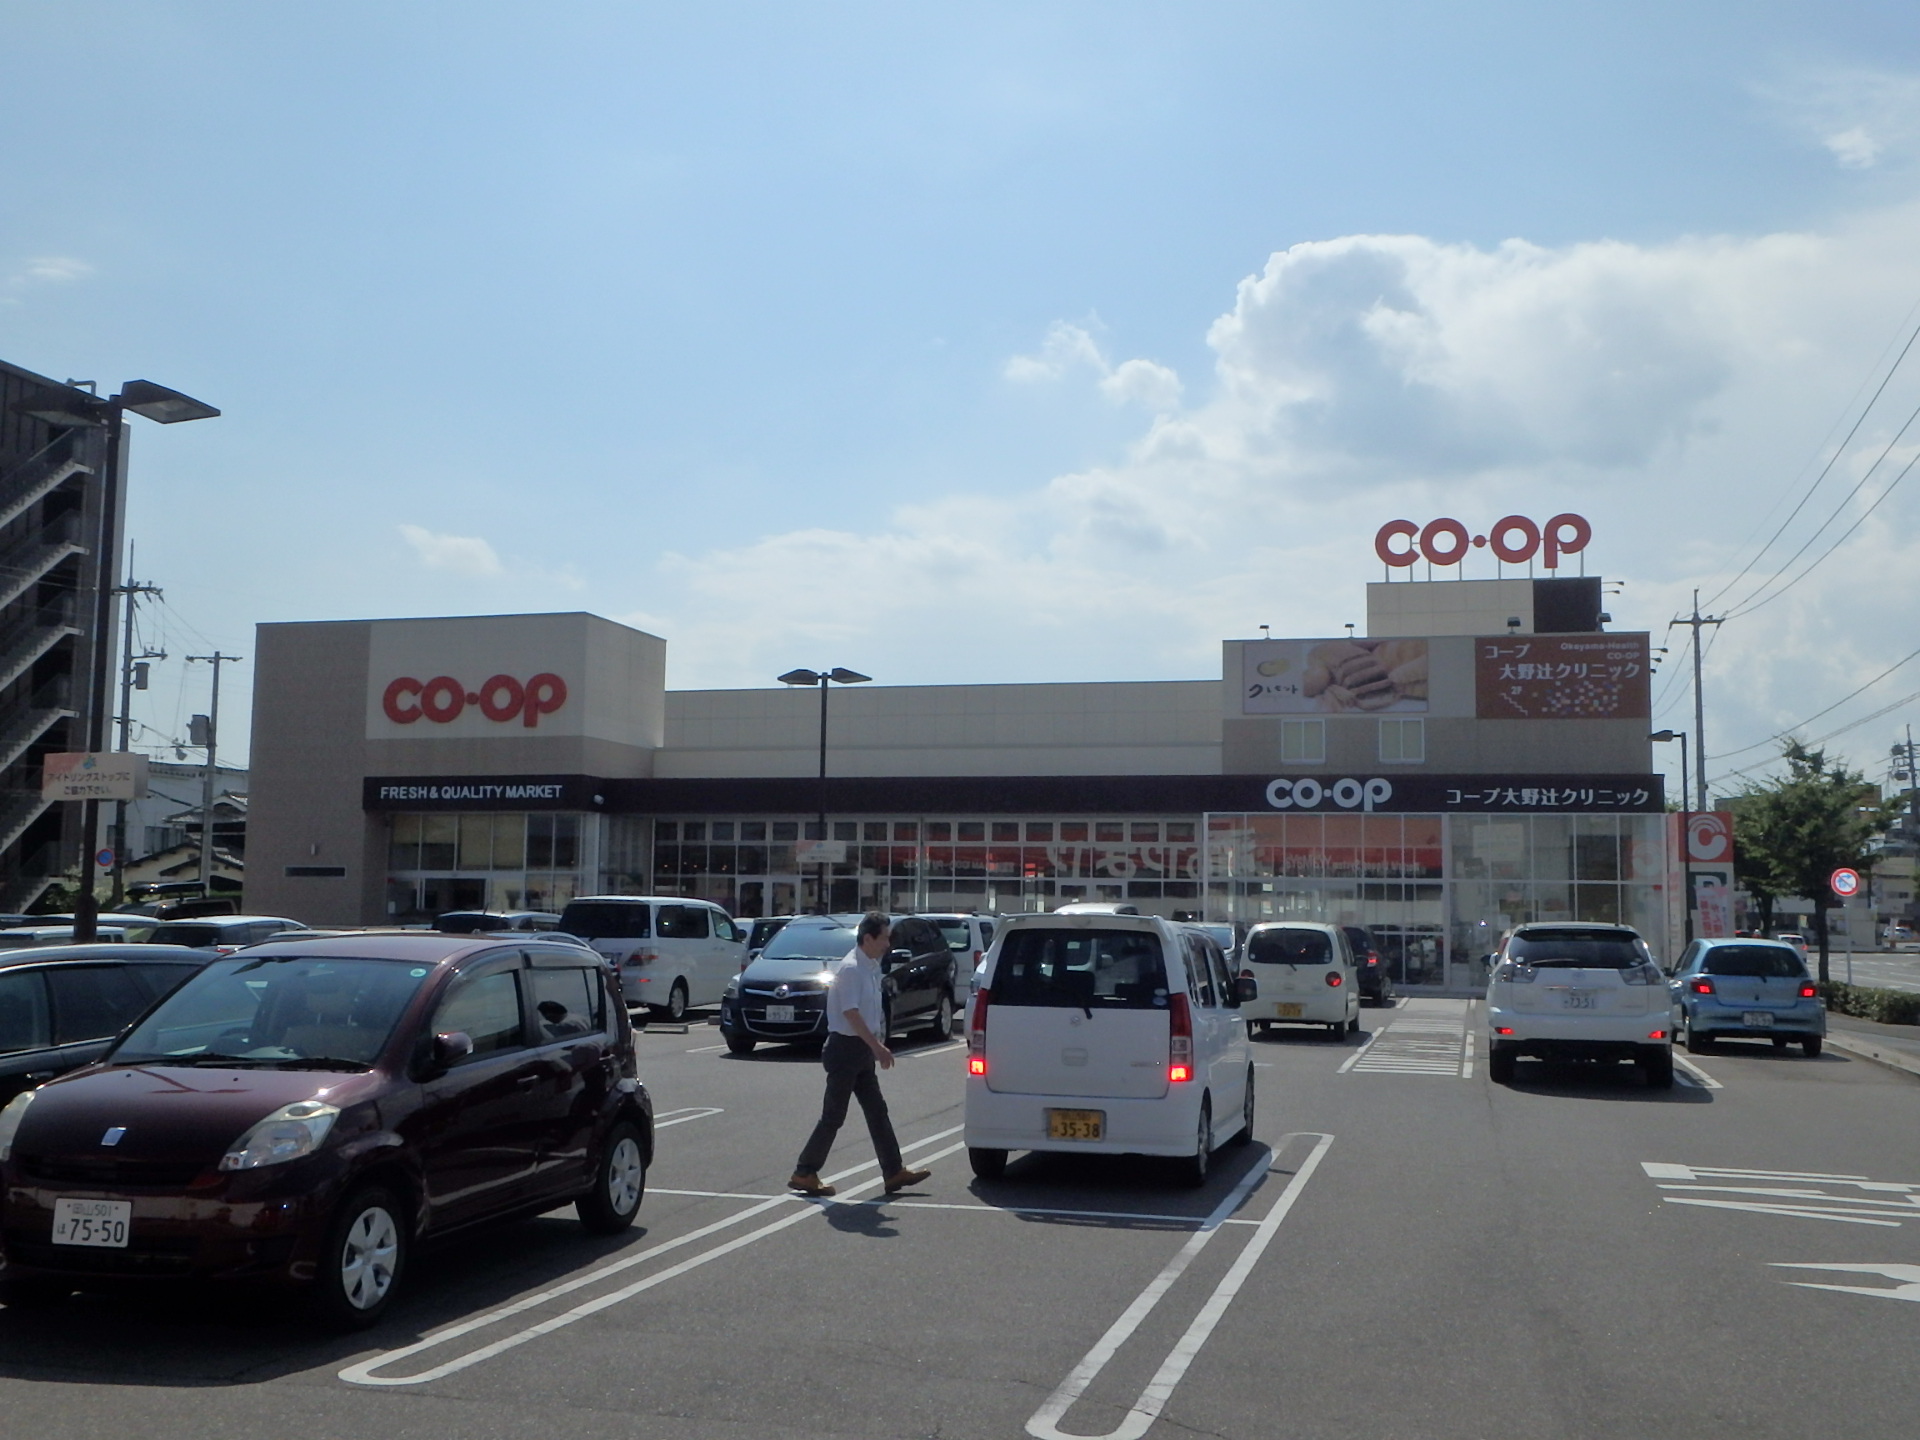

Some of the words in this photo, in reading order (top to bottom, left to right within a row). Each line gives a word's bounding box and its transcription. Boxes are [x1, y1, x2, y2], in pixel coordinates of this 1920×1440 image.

[1499, 662, 1640, 680] 大野辻クリニック
[1510, 686, 1523, 695] 2F
[381, 785, 428, 799] FRESH
[441, 785, 502, 799] QUALITY
[505, 784, 563, 798] MARKET
[1446, 787, 1650, 806] コープ大野辻クリニック
[1060, 1121, 1100, 1138] 35-38
[70, 1218, 124, 1243] 75-50
